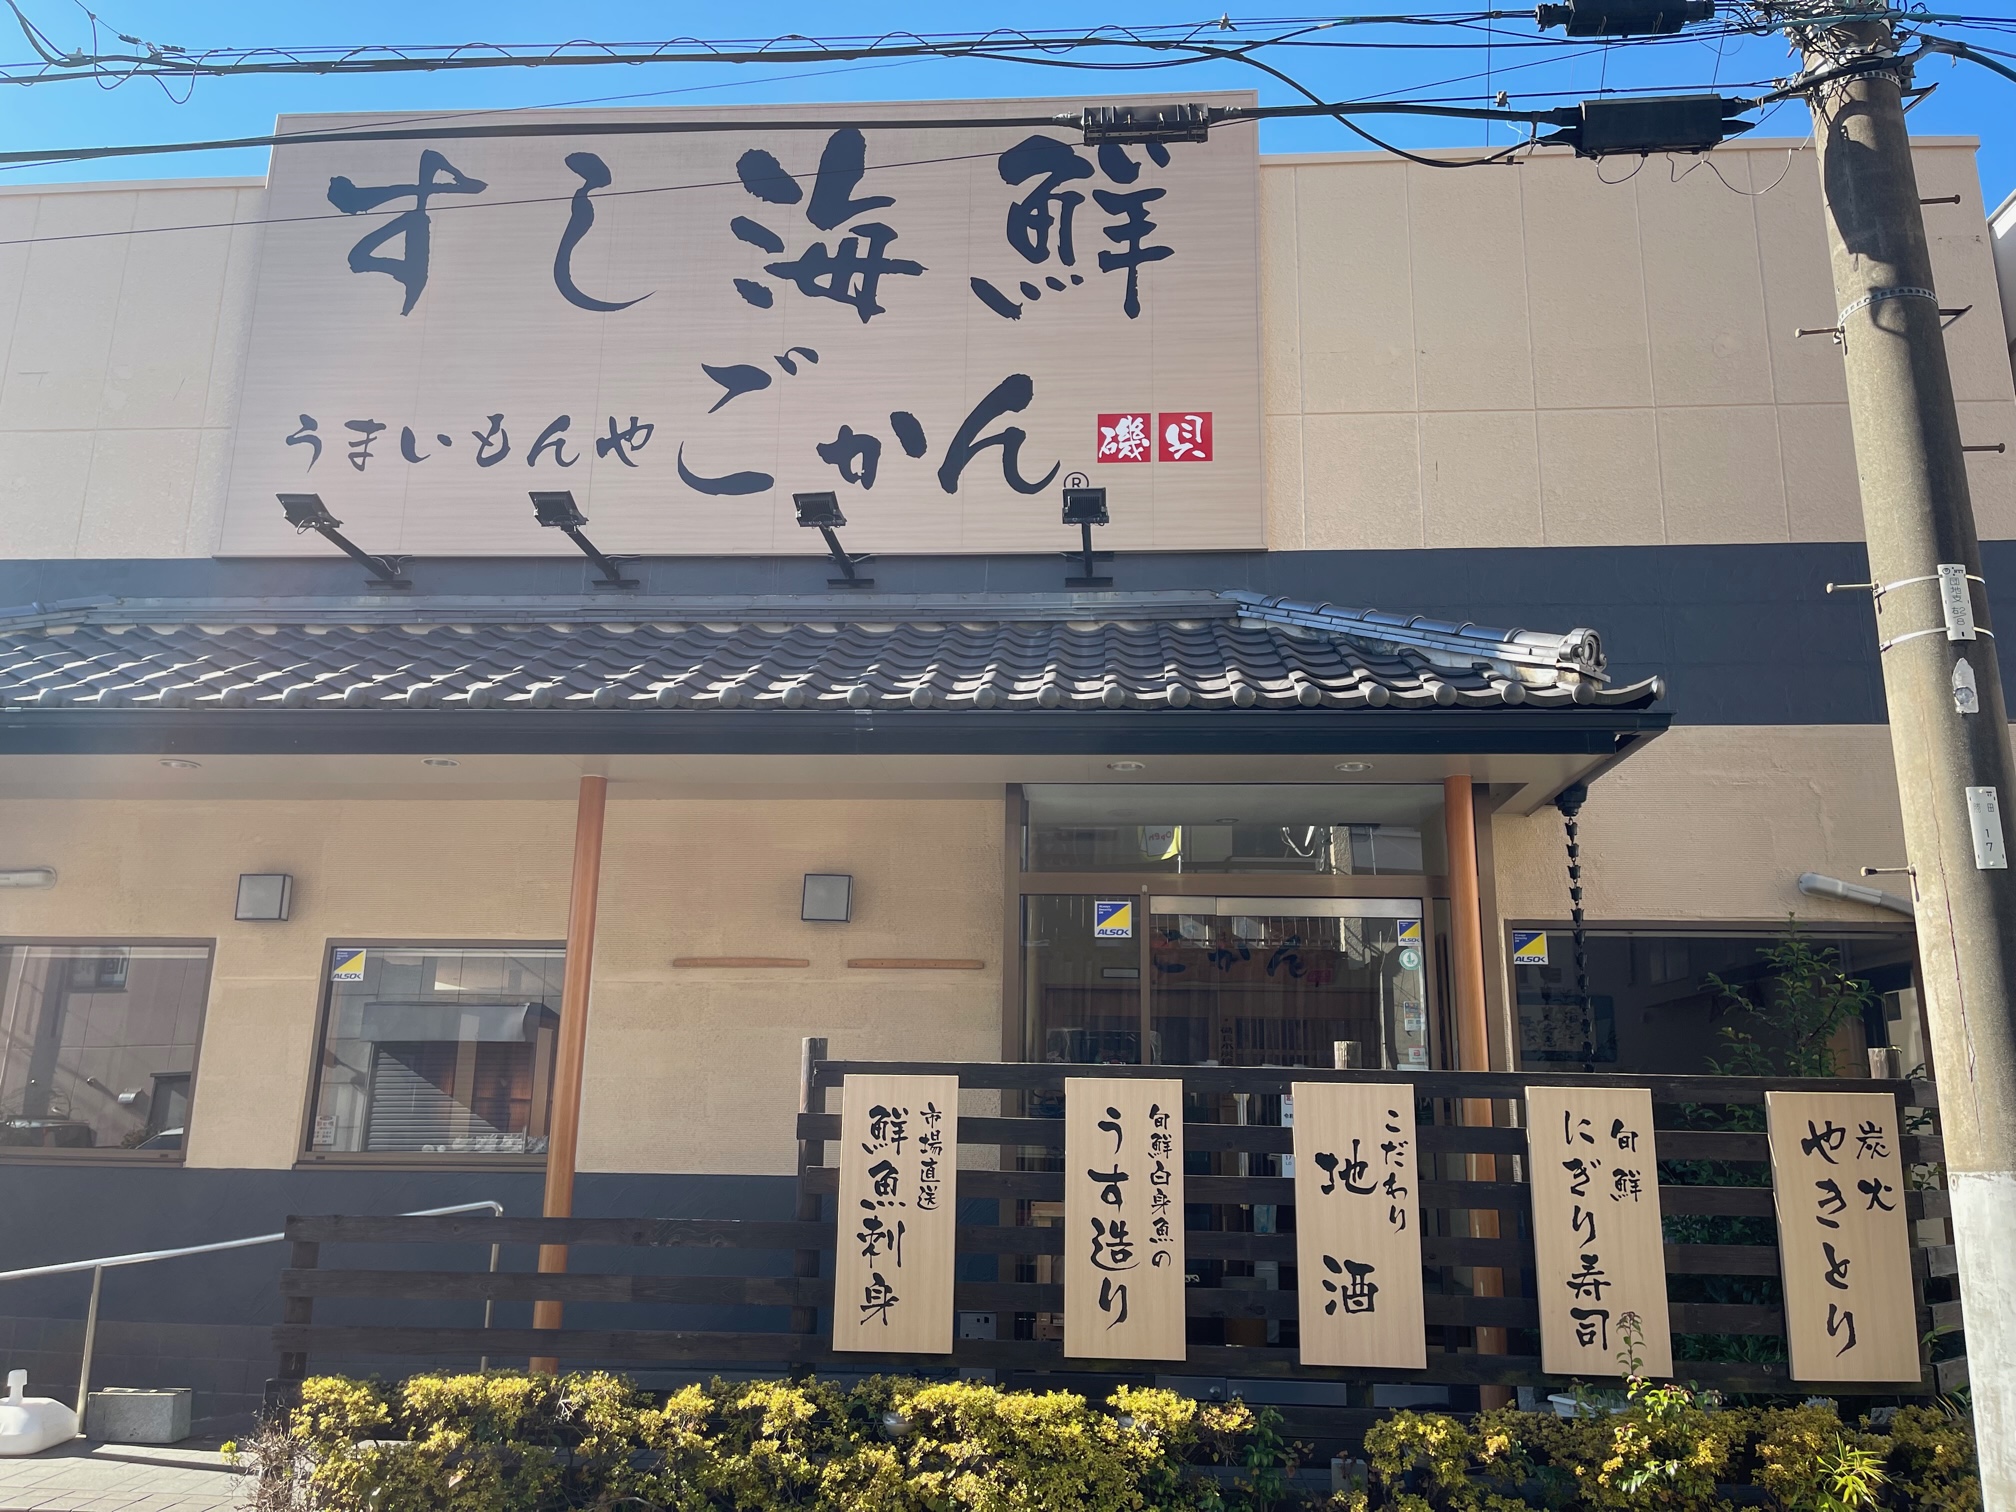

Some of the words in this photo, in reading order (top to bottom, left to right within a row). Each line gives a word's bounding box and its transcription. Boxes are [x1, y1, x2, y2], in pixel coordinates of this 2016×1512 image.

[285, 413, 655, 475] うまいもんや
[677, 346, 1061, 496] ごかん
[856, 1104, 909, 1327] 鮮魚刺身
[916, 1101, 943, 1211] 市場直送
[1087, 1106, 1140, 1331] うす造り
[1147, 1103, 1174, 1268] 旬鮮白身魚の
[1314, 1138, 1379, 1316] 地酒
[1380, 1109, 1409, 1234] こだわり
[1561, 1110, 1612, 1351] にぎり寿司
[1609, 1118, 1643, 1203] 旬鮮
[1855, 1120, 1897, 1211] 炭火
[1800, 1119, 1857, 1358] やきとり
